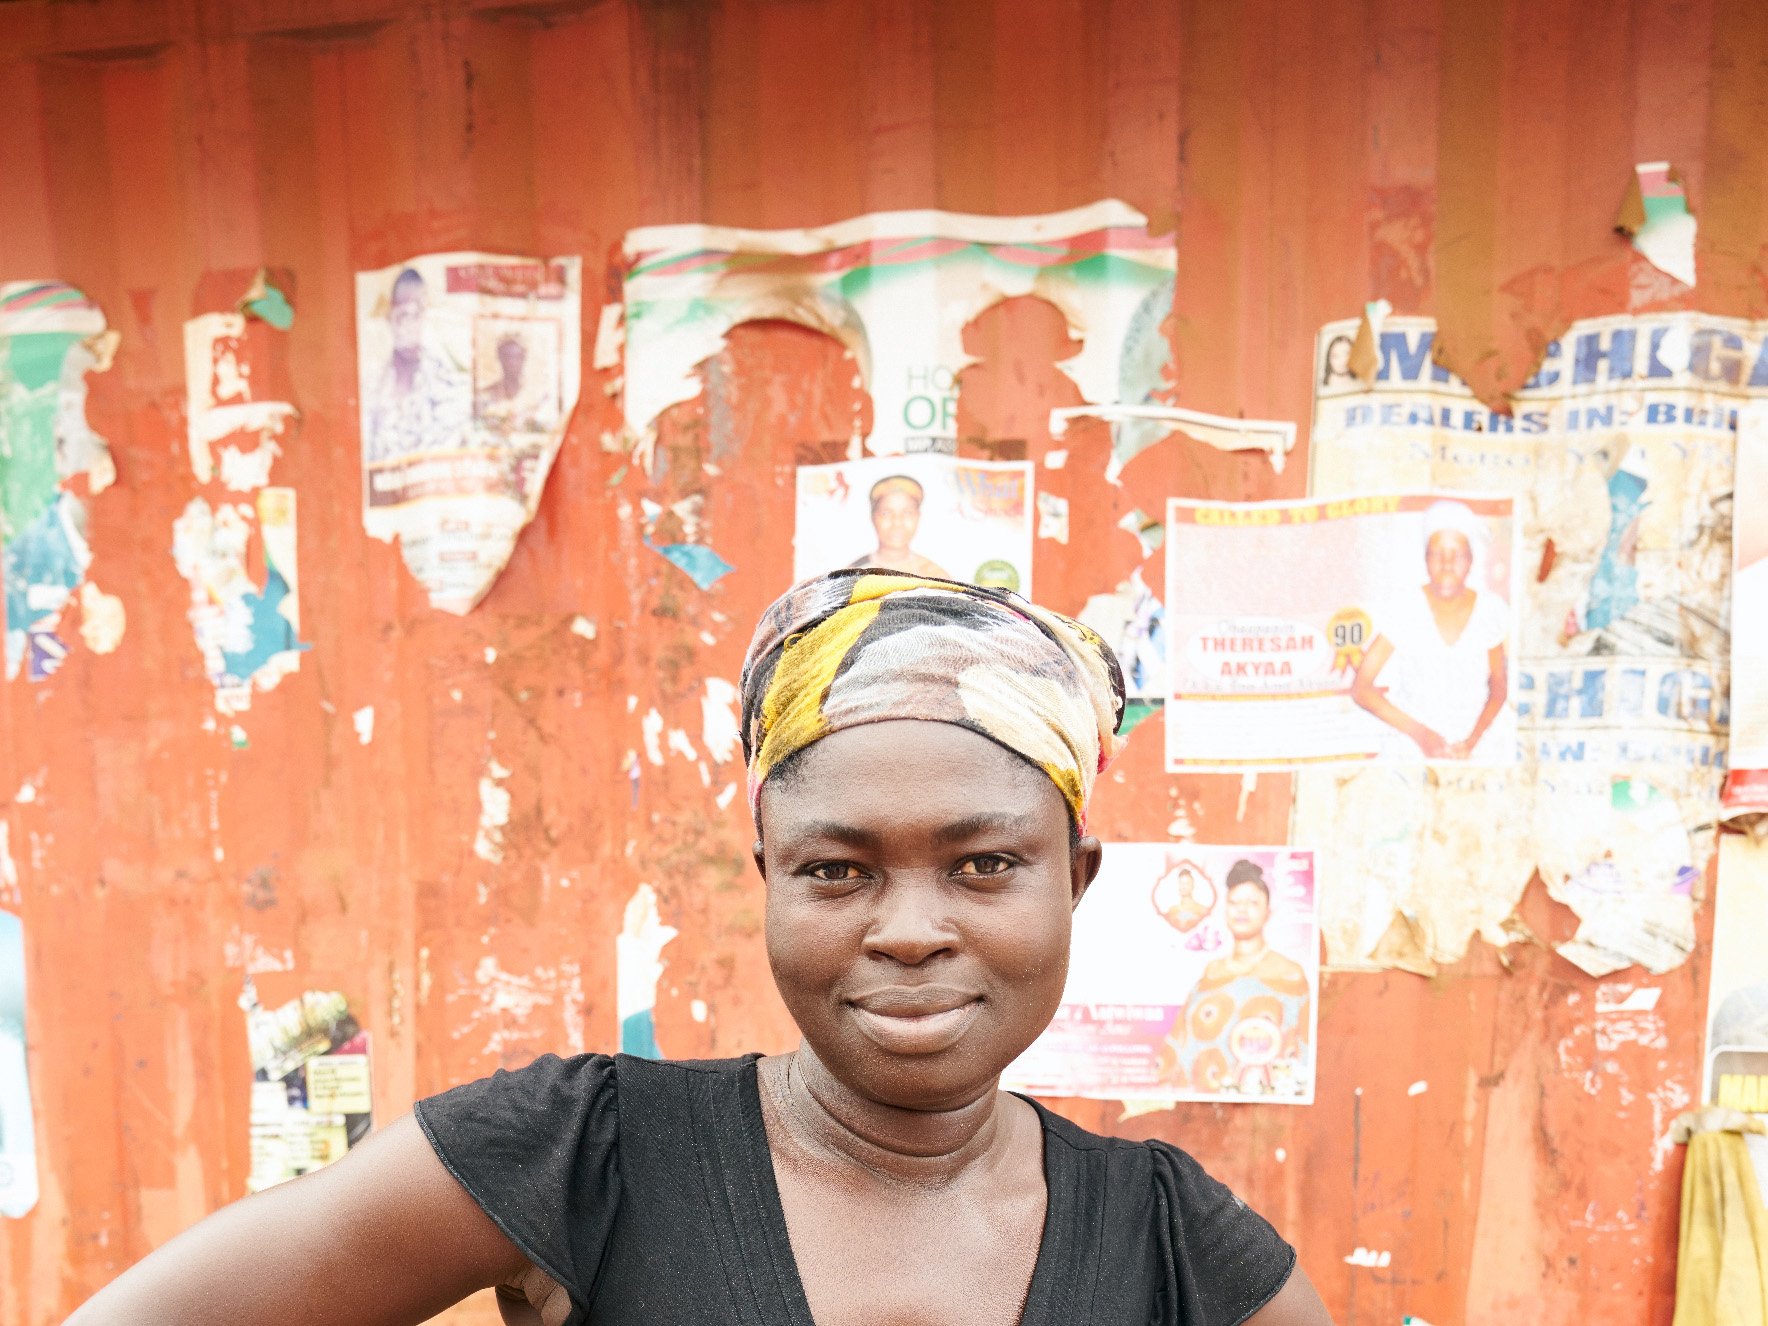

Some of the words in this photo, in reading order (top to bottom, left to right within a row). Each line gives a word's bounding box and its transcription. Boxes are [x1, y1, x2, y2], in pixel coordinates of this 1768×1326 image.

[1344, 403, 1549, 434] DEALERS
[1194, 508, 1282, 526] CALLED
[1288, 506, 1319, 523] TO
[1325, 495, 1401, 519] GLORY
[1200, 636, 1314, 652] THERESAH
[1335, 623, 1363, 647] 90
[1220, 661, 1293, 677] AKYAA
